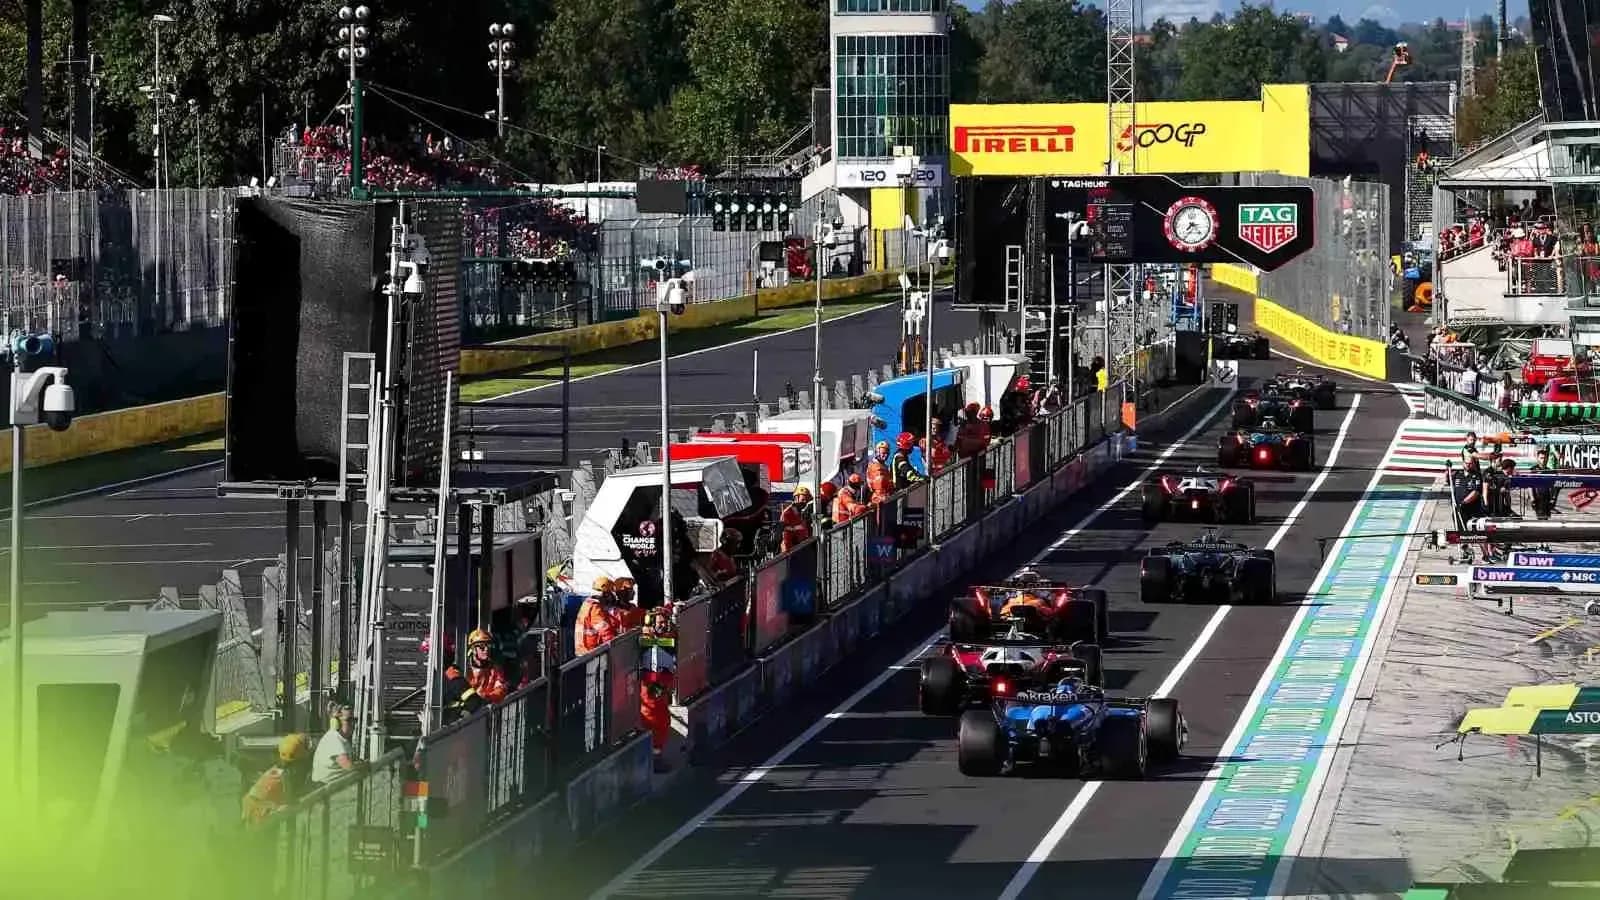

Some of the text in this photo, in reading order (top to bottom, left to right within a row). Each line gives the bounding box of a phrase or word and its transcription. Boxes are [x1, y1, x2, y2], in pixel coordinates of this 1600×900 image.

[954, 126, 1075, 153] PIRELLI
[860, 170, 886, 181] 120
[914, 169, 936, 181] 20
[1243, 207, 1292, 222] TAG
[1242, 226, 1294, 249] HEUER
[1531, 556, 1555, 567] BWT
[1488, 571, 1597, 582] BWT MSC
[1565, 711, 1600, 724] ASTO
